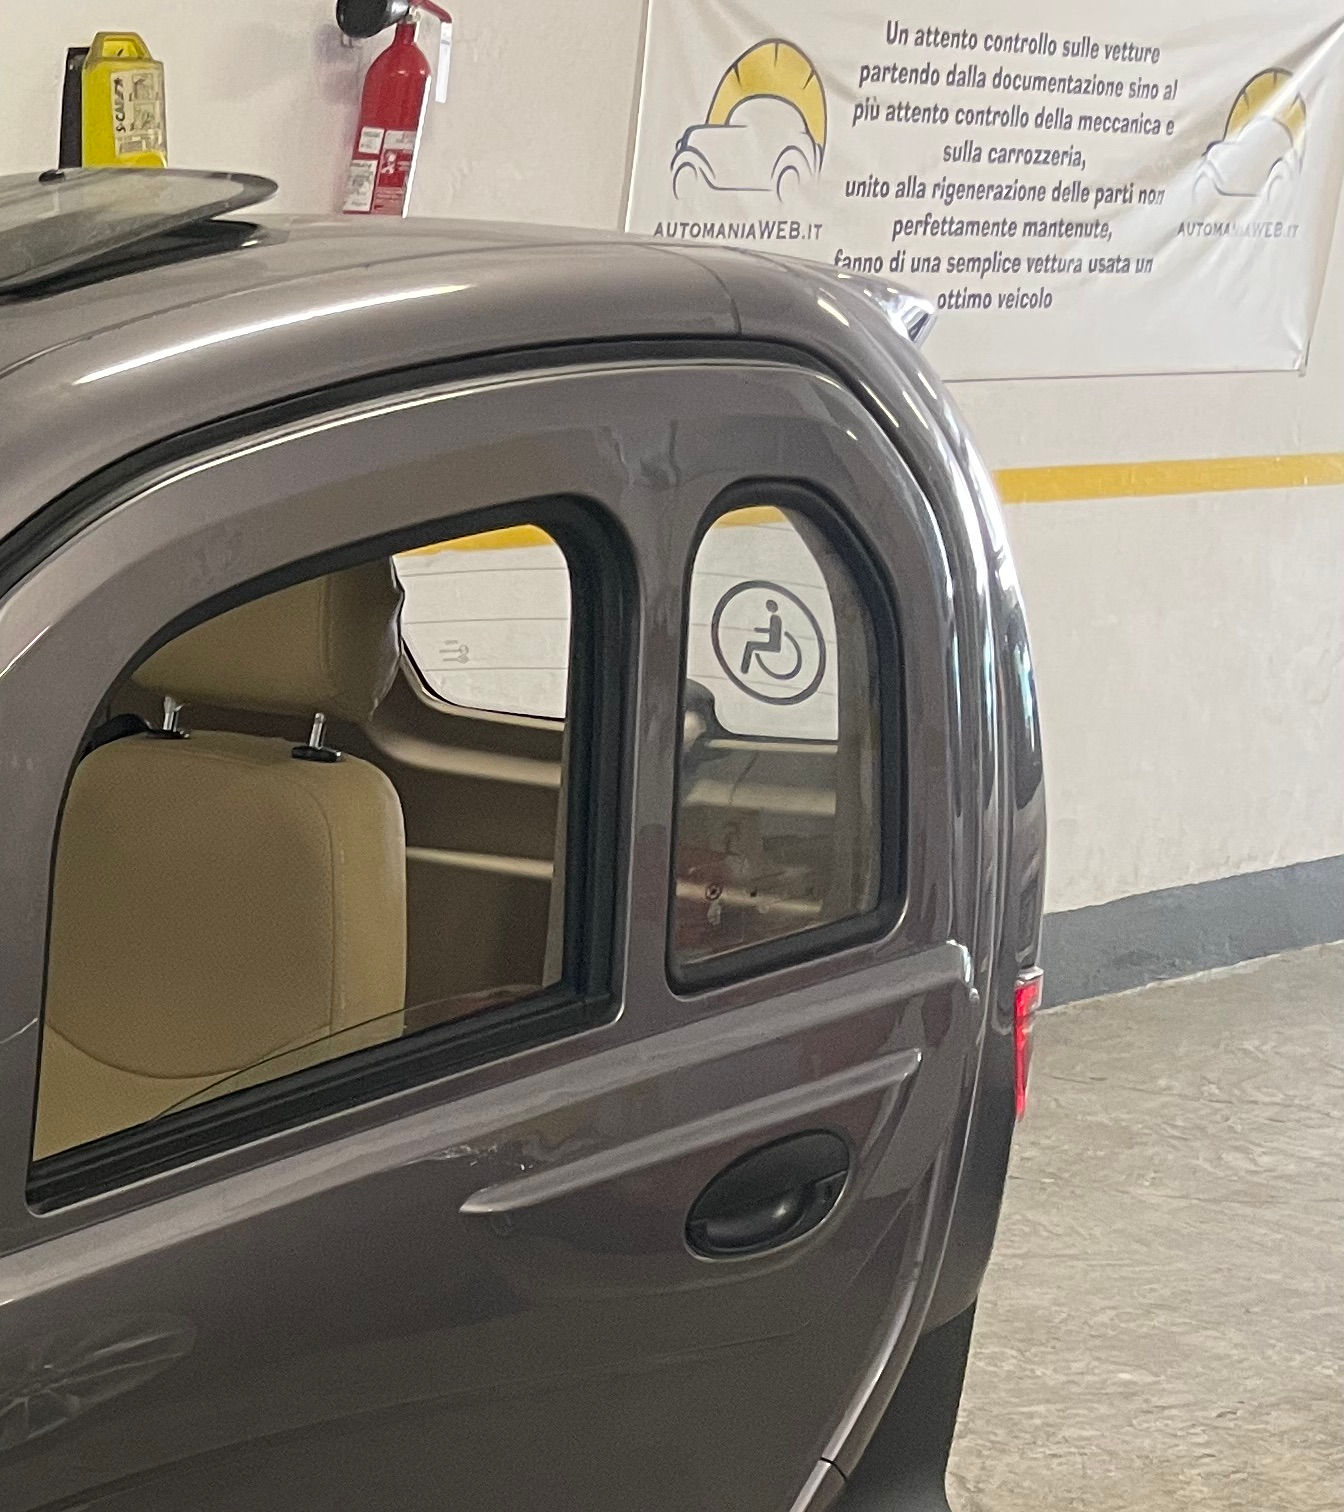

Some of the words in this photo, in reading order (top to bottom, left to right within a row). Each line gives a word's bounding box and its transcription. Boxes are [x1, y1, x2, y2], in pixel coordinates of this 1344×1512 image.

[886, 19, 909, 45] Un
[914, 25, 978, 51] attento
[983, 31, 1057, 56] controllo
[1062, 35, 1099, 60] sulle
[1104, 41, 1160, 64] vetture
[859, 61, 940, 88] partendo
[946, 62, 987, 88] dalla
[992, 65, 1124, 98] documentazione
[1128, 76, 1159, 100] sino
[1162, 78, 1178, 101] al
[852, 96, 880, 127] più
[885, 101, 949, 125] attento
[955, 104, 1029, 128] controllo
[1034, 105, 1073, 131] della
[1077, 112, 1161, 135] meccanica
[1165, 119, 1175, 136] e
[943, 139, 982, 163] sulla
[987, 144, 1086, 171] carrozzeria,
[845, 173, 890, 198] unito
[895, 174, 927, 199] alla
[931, 175, 1046, 207] rigenerazione
[1051, 179, 1090, 204] delle
[1093, 182, 1134, 209] parti
[1137, 187, 1165, 205] non
[653, 219, 823, 240] AUTOMANIAWEB.IT
[892, 211, 1018, 242] perfettamente
[1022, 217, 1113, 242] mantenute,
[1177, 220, 1299, 239] AUTOMAAWEB.IT
[834, 248, 884, 274] fanno
[889, 249, 906, 274] di
[910, 255, 942, 274] una
[946, 250, 1021, 280] semplice
[1026, 253, 1082, 274] vettura
[1088, 254, 1130, 274] usata
[1134, 257, 1154, 274] un
[937, 286, 992, 310] ottimo
[997, 286, 1053, 309] veicolo
